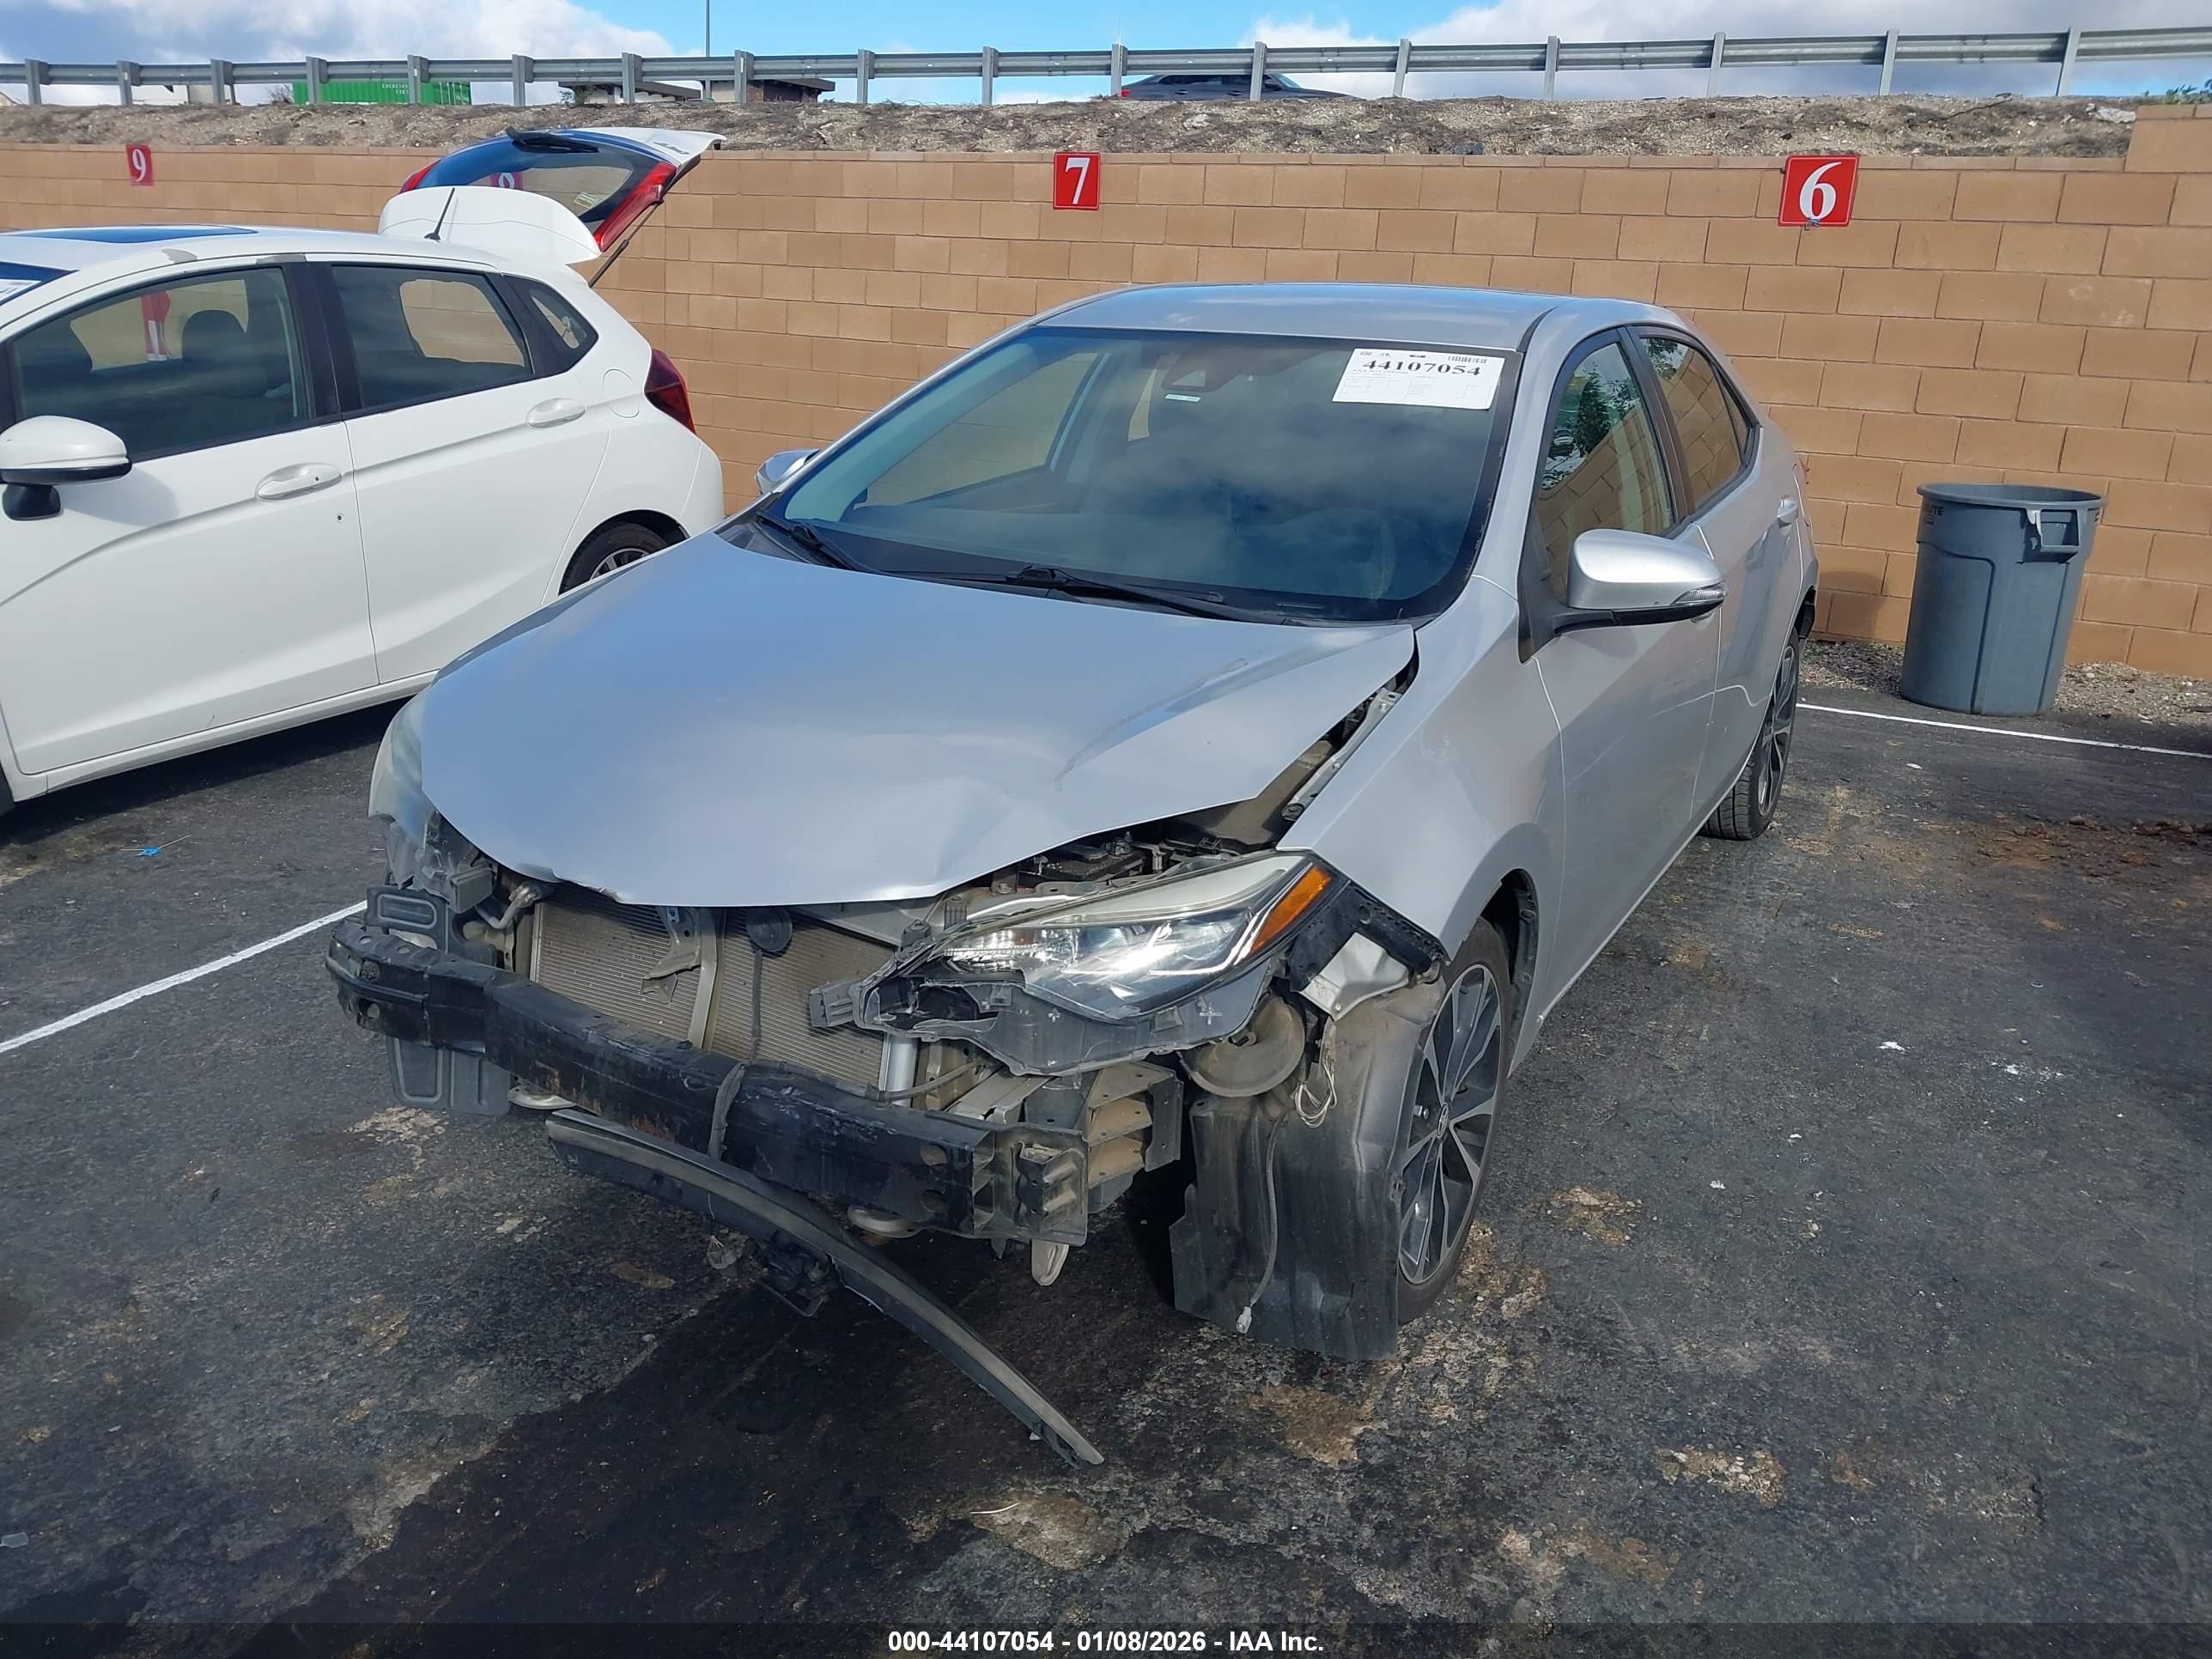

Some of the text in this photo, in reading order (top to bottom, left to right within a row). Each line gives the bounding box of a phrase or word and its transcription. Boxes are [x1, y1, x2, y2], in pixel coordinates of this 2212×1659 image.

[132, 149, 146, 182] 9
[1066, 158, 1091, 204] 7
[1800, 161, 1841, 220] 6
[1363, 359, 1481, 376] 44107054
